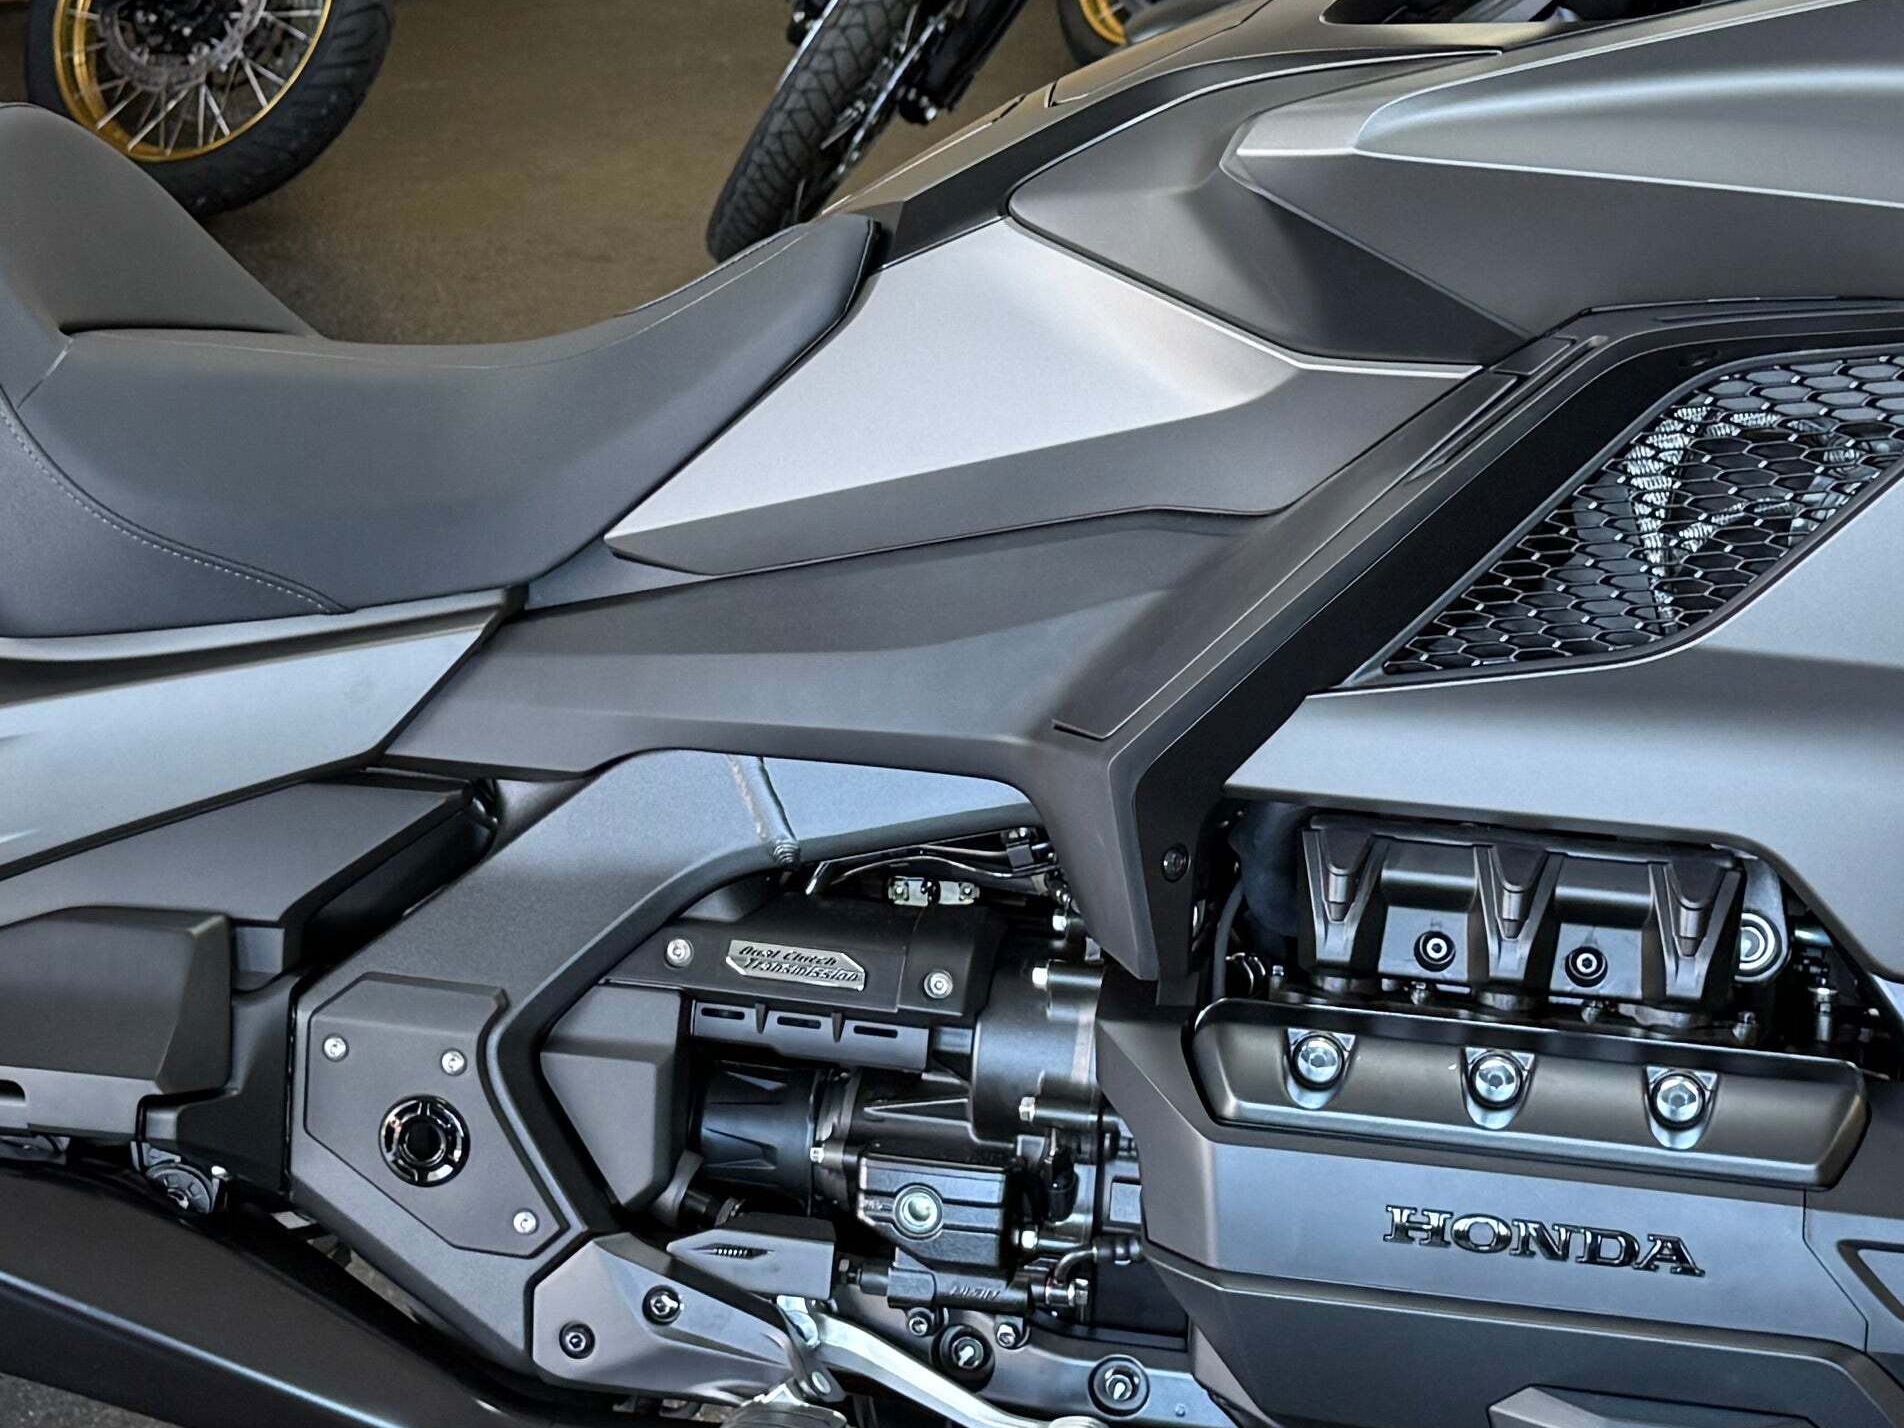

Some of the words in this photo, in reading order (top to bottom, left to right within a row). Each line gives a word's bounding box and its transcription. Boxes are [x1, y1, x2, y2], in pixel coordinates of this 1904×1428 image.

[738, 945, 781, 960] Dual
[782, 949, 837, 967] Clutch
[744, 957, 860, 982] Transmission
[1383, 1204, 1706, 1277] HONDA
